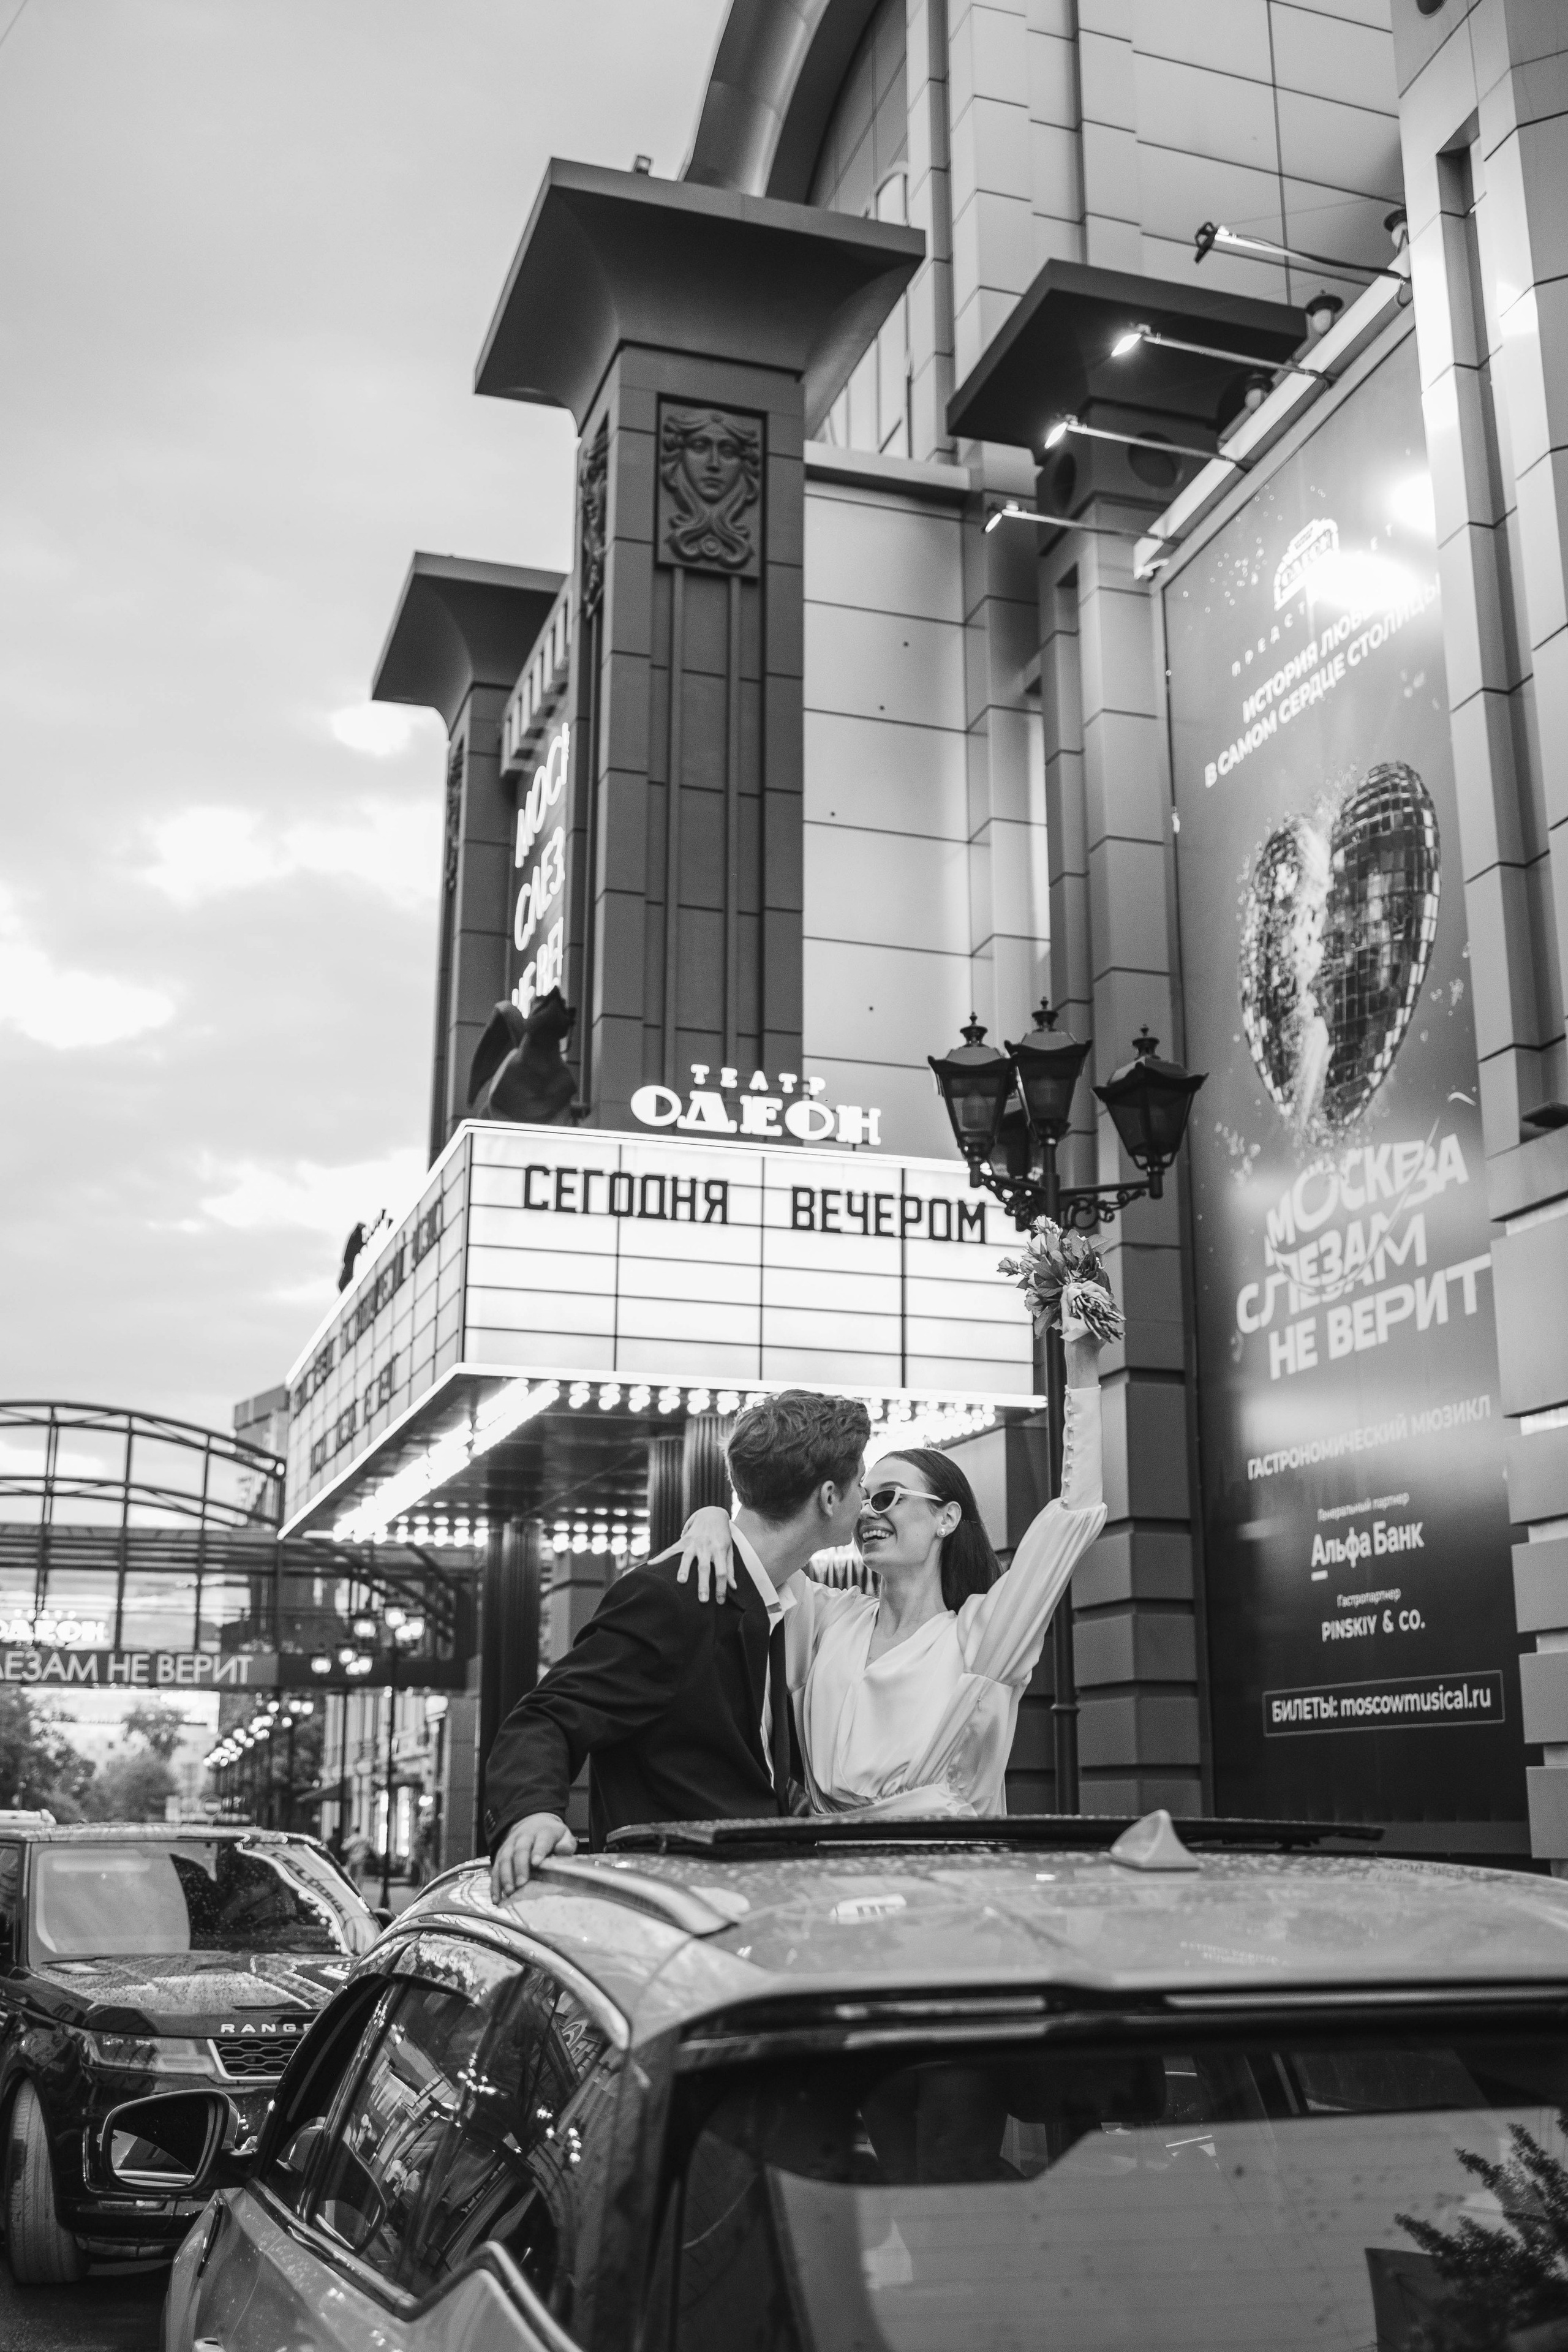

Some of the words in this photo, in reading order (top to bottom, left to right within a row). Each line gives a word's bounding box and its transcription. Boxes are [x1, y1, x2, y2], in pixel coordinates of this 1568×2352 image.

[1204, 761, 1218, 788] В
[1218, 712, 1277, 776] САМОМ
[1278, 652, 1346, 725] СЕРДЦЕ
[1242, 640, 1318, 724] ИСТОРИЯ
[630, 1085, 881, 1145] ОДЕОН
[691, 1064, 826, 1096] ТЕАТР
[523, 1165, 729, 1224] СЕГОДНЯ
[792, 1186, 986, 1245] ВЕЧЕРОМ
[1265, 1133, 1469, 1246] МОСКВА
[1236, 1213, 1427, 1333] СЛЕЗАМ
[1268, 1316, 1318, 1381] НЕ
[1327, 1253, 1492, 1360] ВЕРИТ
[1247, 1413, 1408, 1481] ГАСТРОНОМИЧЕСКИЙ
[1412, 1395, 1491, 1437] МЮЗИКЛ
[1311, 1526, 1372, 1568] Альфа
[1373, 1520, 1425, 1556] Банк
[1321, 1614, 1378, 1642] PINSKIY
[1382, 1609, 1394, 1634] &
[1399, 1608, 1426, 1632] CO.
[107, 1653, 151, 1683] НЕ
[157, 1653, 254, 1685] ВЕРИТ
[1272, 1695, 1338, 1723] БИЛЕТЫ:
[1340, 1683, 1491, 1717] moscowmusical.ru
